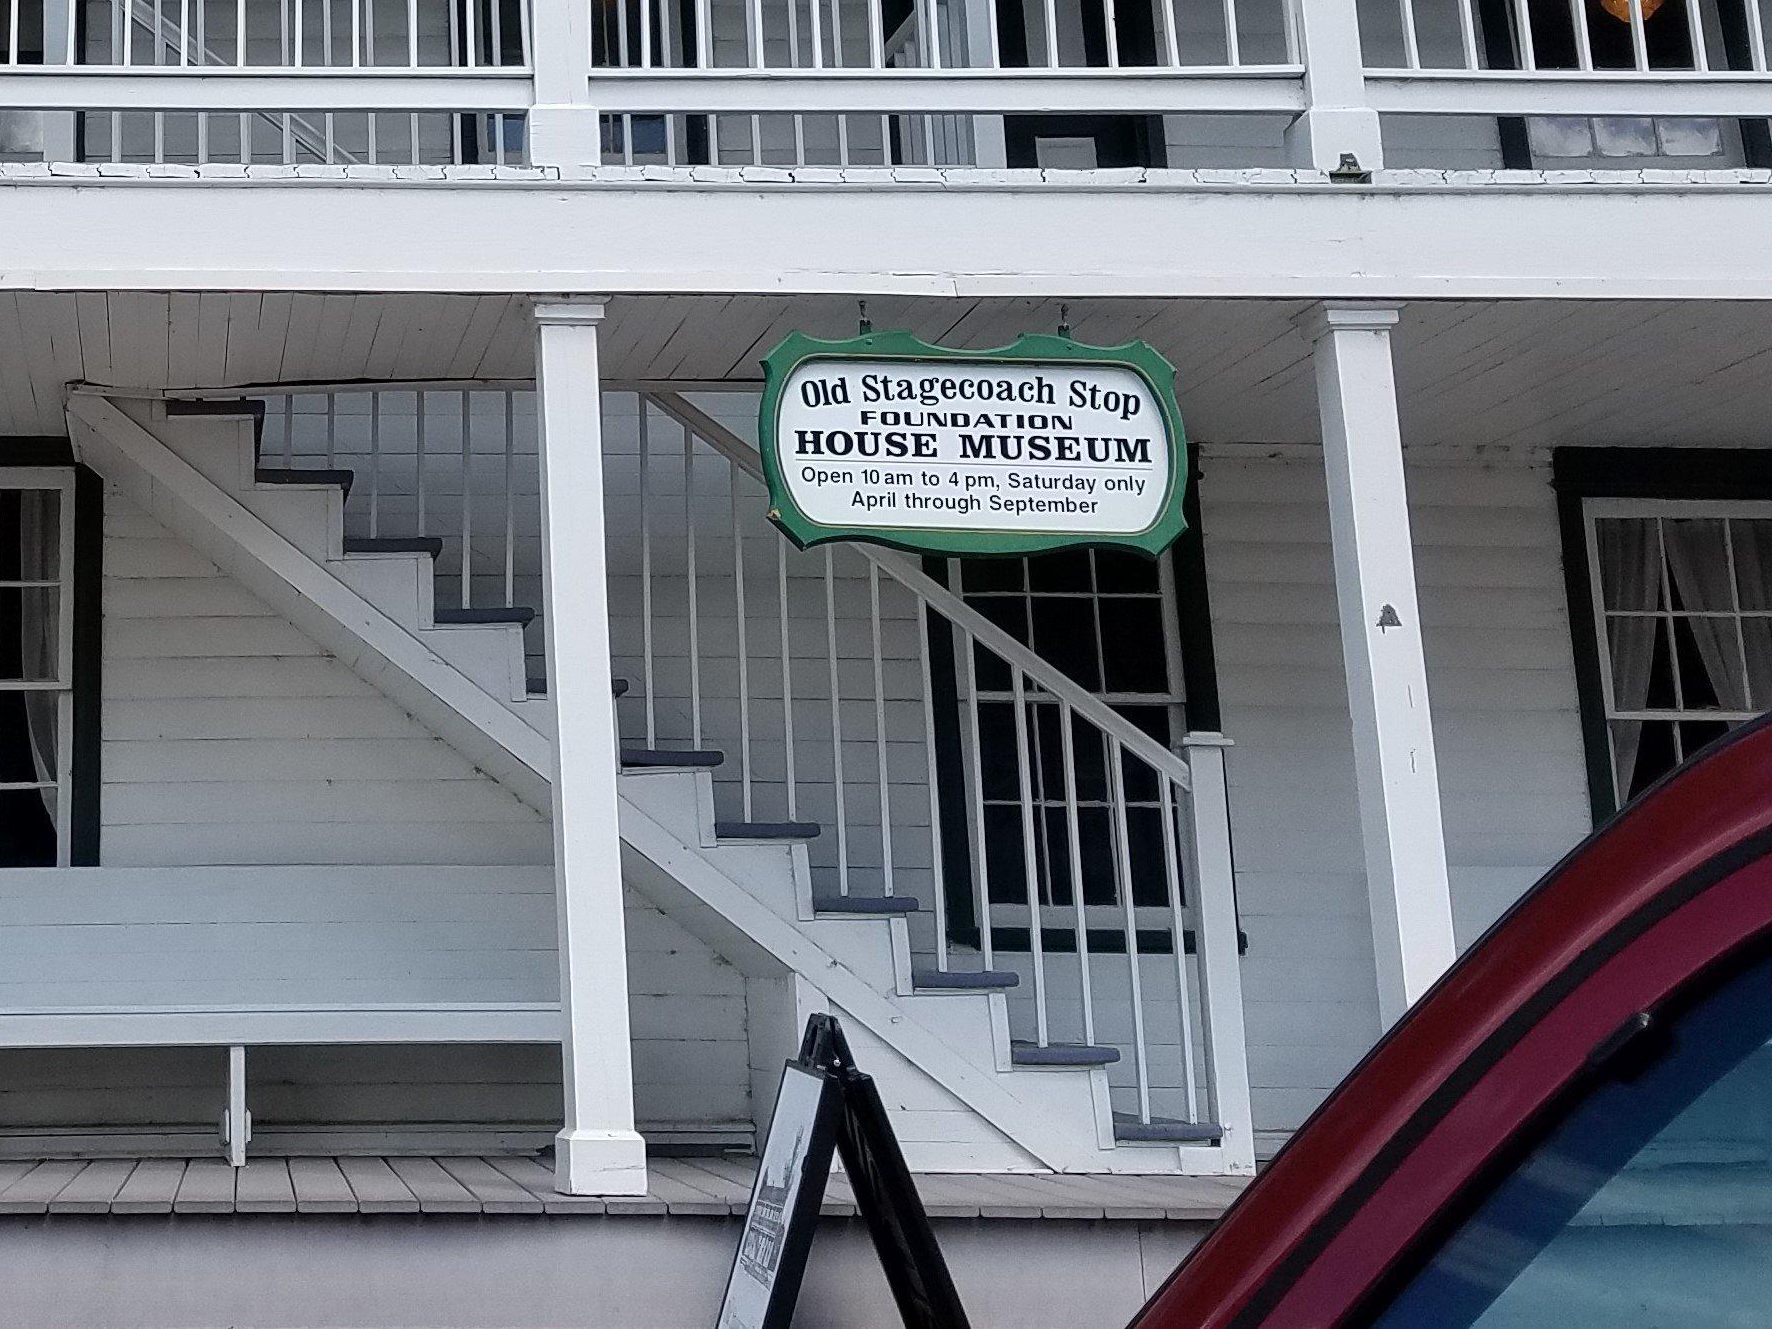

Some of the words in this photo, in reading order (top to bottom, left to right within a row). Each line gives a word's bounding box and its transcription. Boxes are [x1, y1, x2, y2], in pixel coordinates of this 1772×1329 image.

[800, 377, 851, 407] Old
[861, 374, 1057, 408] Stagecoach
[1068, 379, 1141, 421] Stop
[860, 410, 1073, 431] FOUNDATION
[794, 430, 938, 458] HOUSE
[958, 433, 1153, 464] MUSEUM
[801, 466, 853, 488] Open
[920, 471, 940, 487] to
[1008, 472, 1097, 495] Saturday
[1104, 476, 1146, 496] only
[851, 490, 896, 512] April
[904, 492, 981, 512] through
[989, 494, 1099, 516] September
